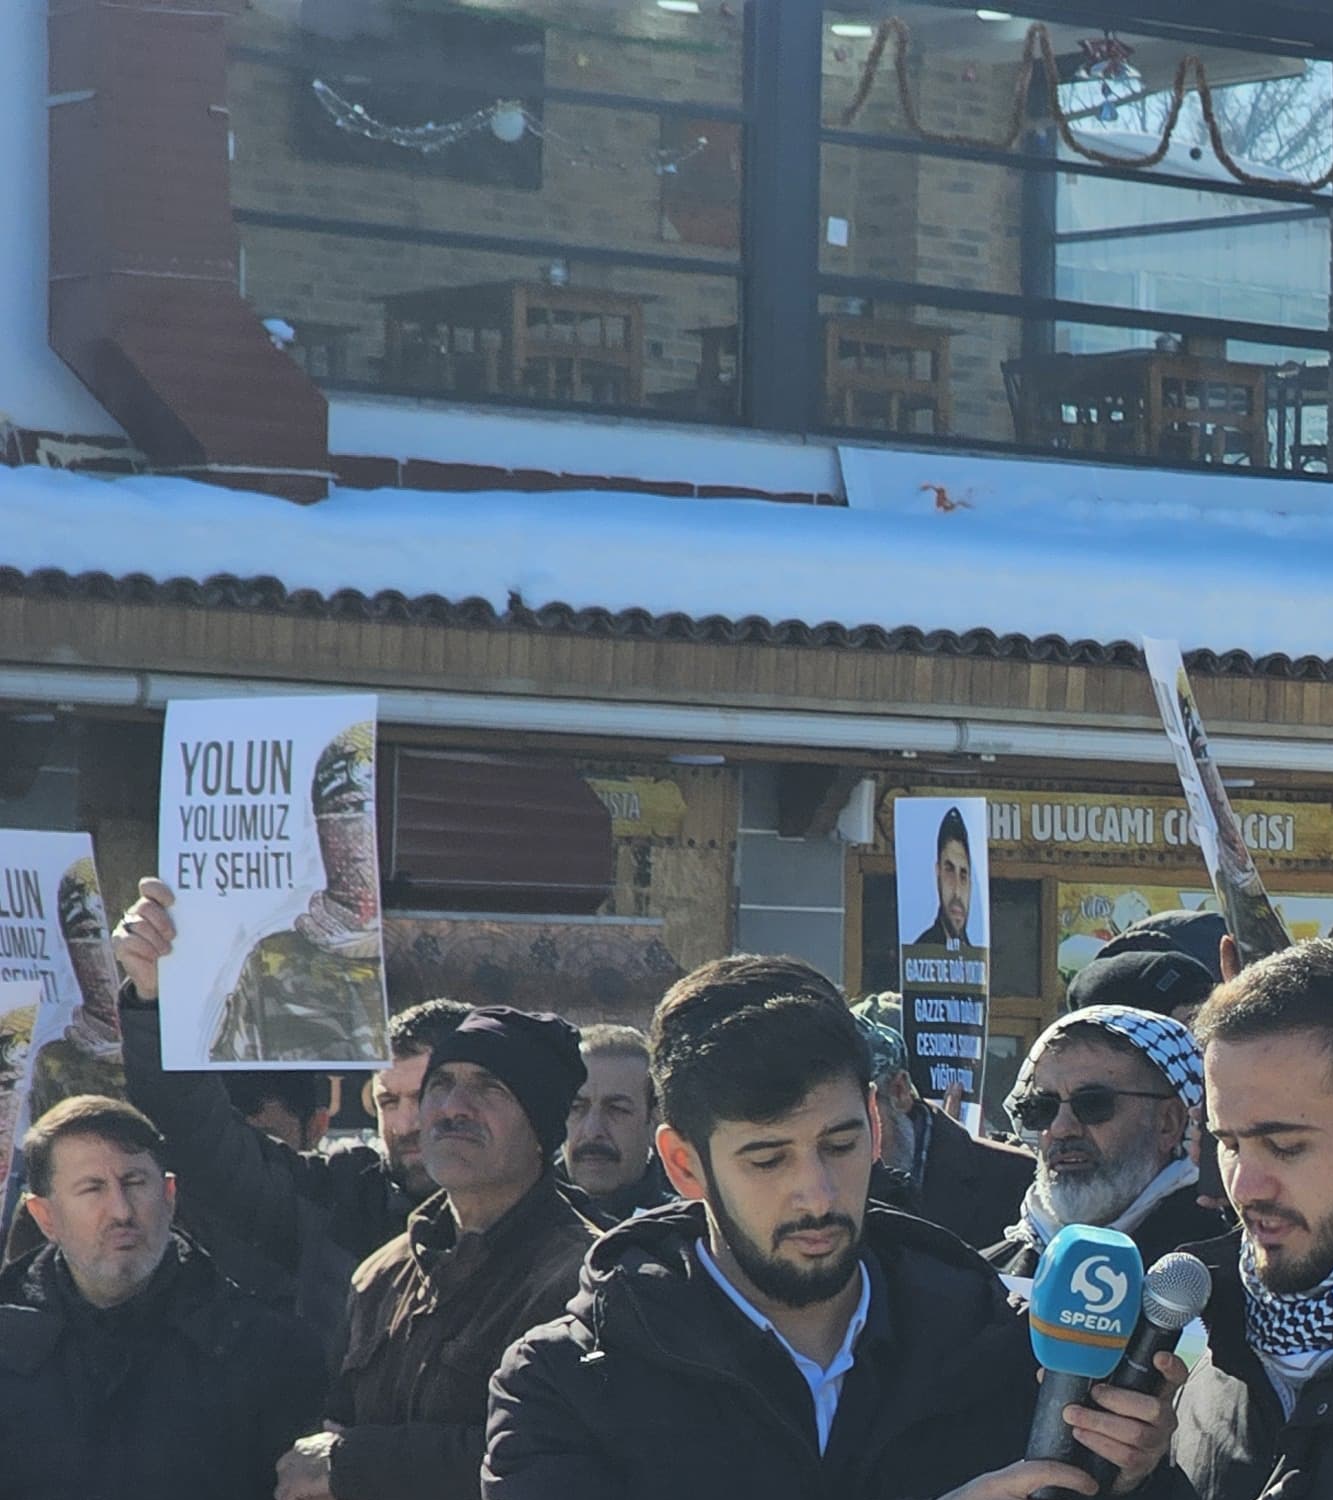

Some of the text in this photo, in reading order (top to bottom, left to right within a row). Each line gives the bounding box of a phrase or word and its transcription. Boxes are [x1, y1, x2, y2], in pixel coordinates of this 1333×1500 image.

[180, 739, 293, 797] YOLUN
[179, 804, 290, 842] YOLUMUZ
[178, 845, 294, 897] EY ŞEHİT!
[1060, 1310, 1121, 1333] SPEDA
